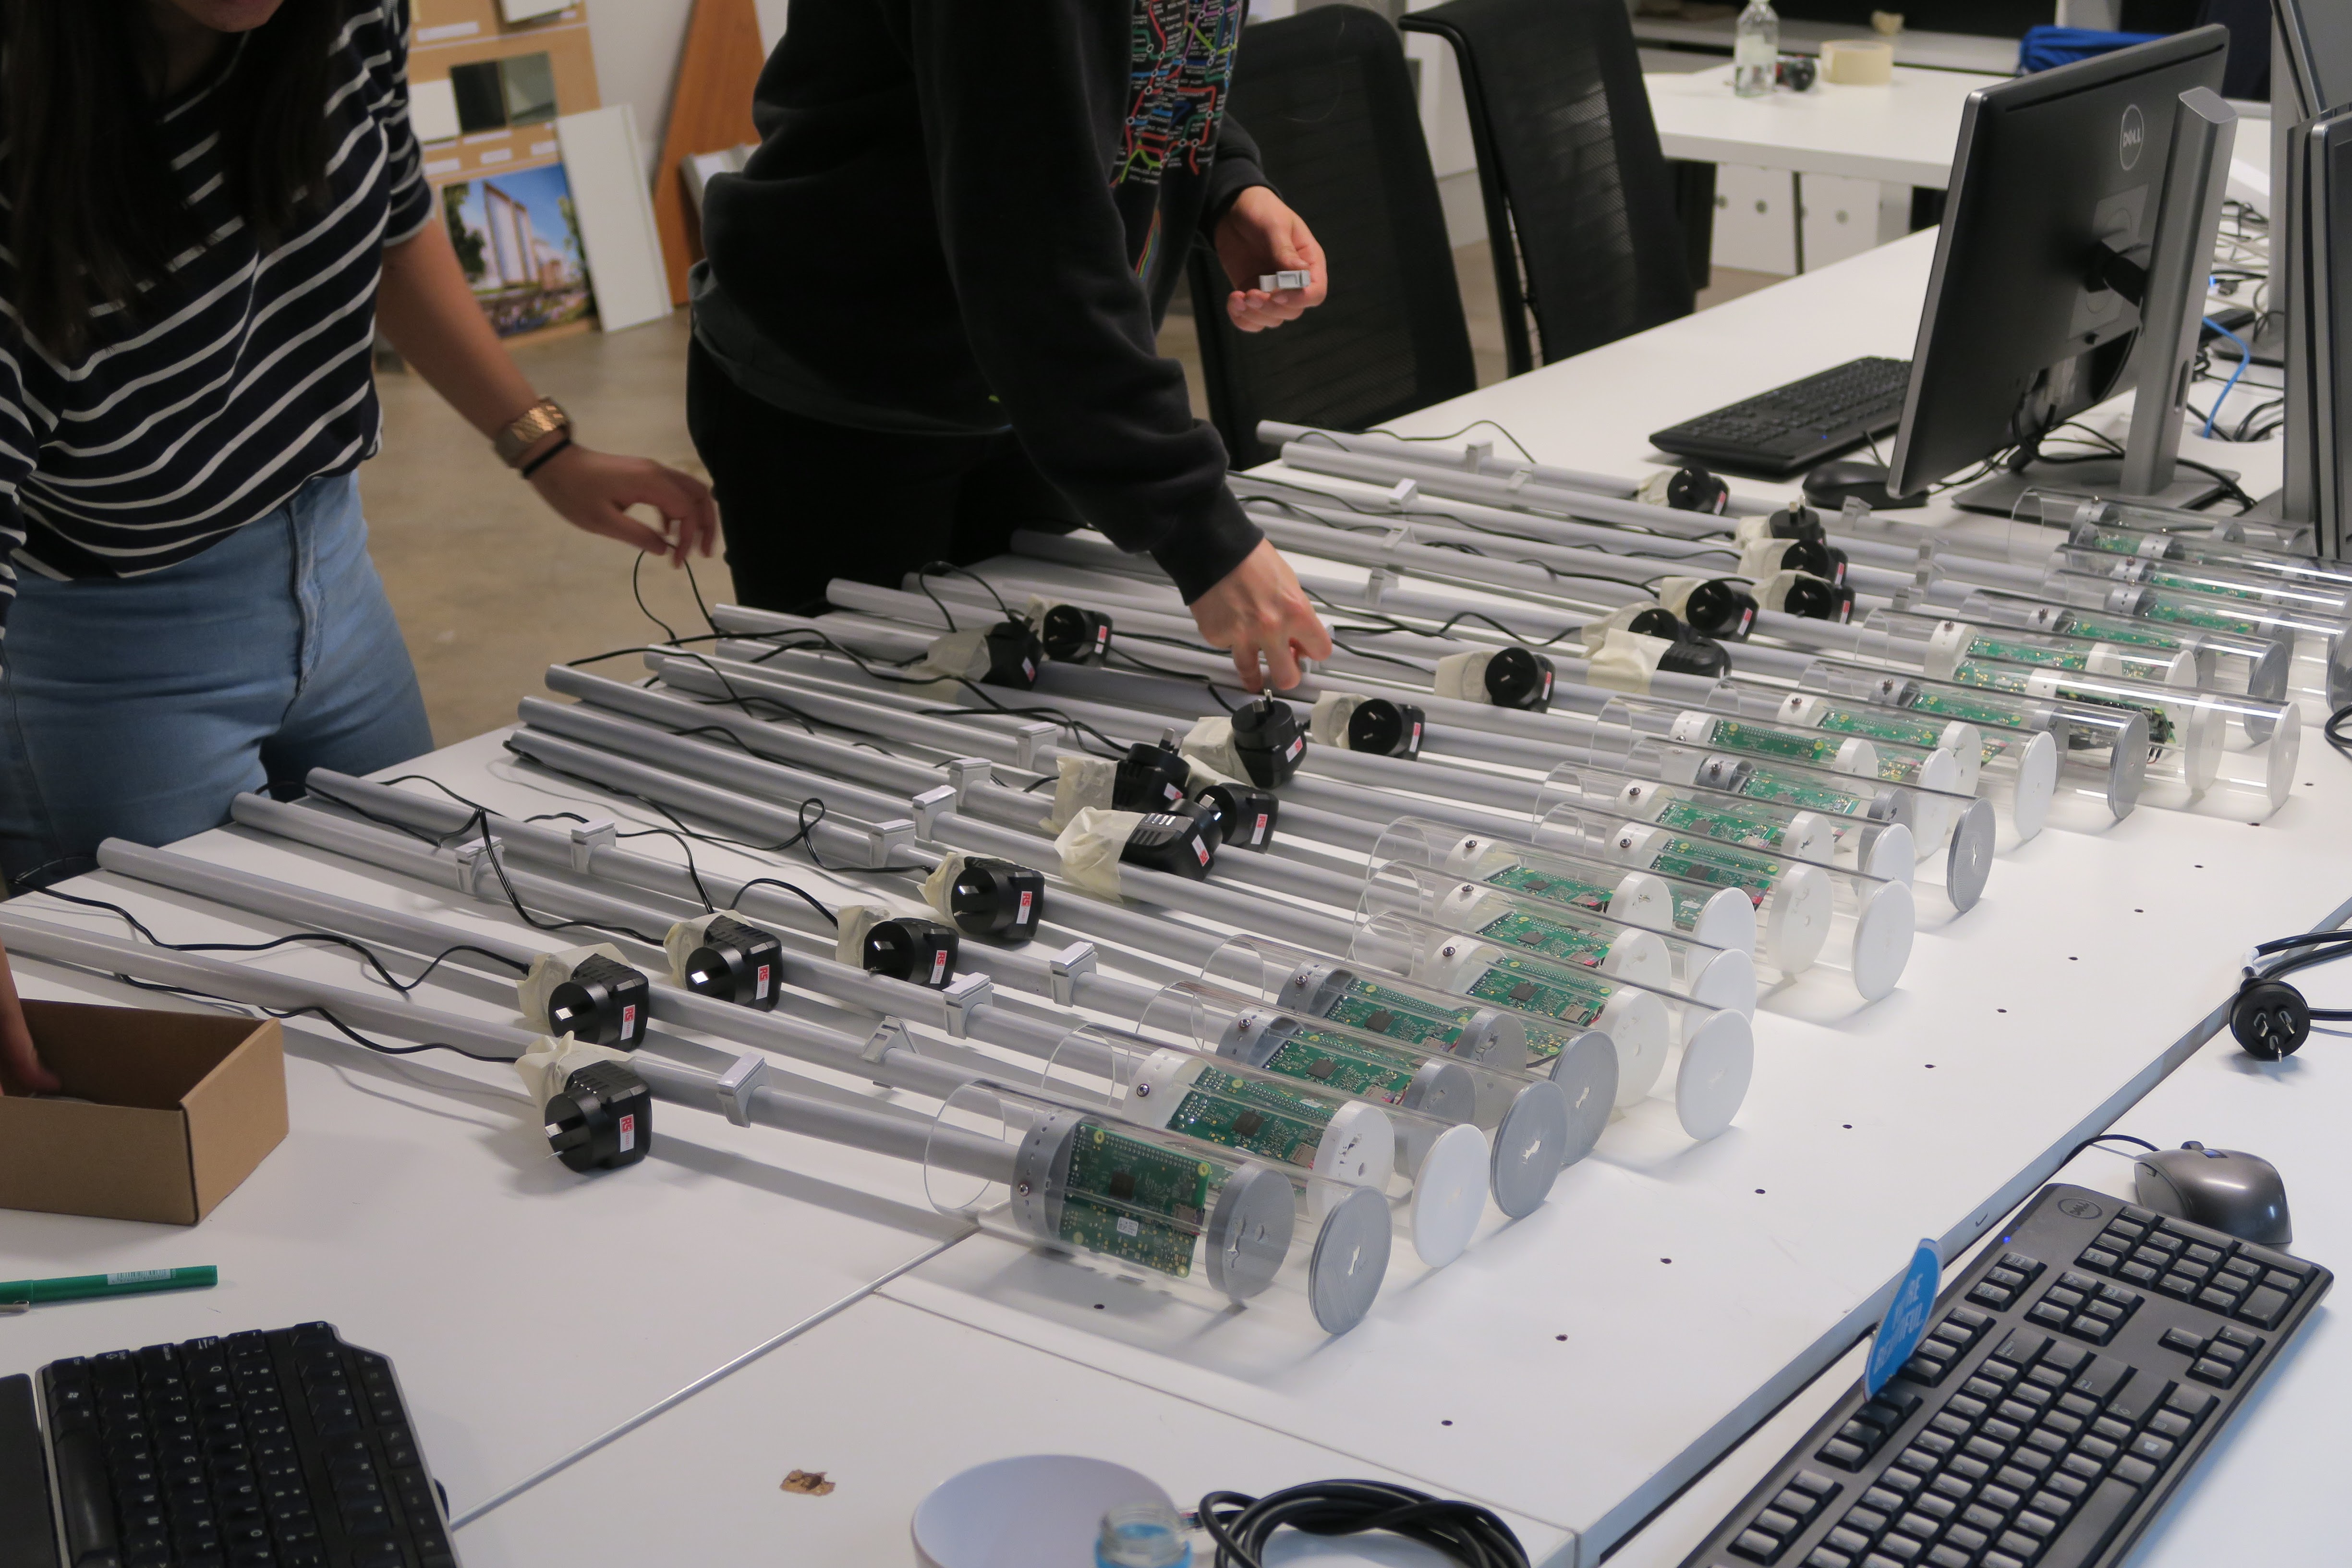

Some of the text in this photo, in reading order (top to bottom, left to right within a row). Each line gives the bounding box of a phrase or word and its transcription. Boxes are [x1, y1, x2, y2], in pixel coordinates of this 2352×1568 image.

[2123, 129, 2140, 147] DELL
[1022, 893, 1031, 906] RS
[936, 952, 946, 966] RS
[759, 966, 768, 981] RS
[625, 1007, 634, 1022] RS
[621, 1117, 633, 1132] RS
